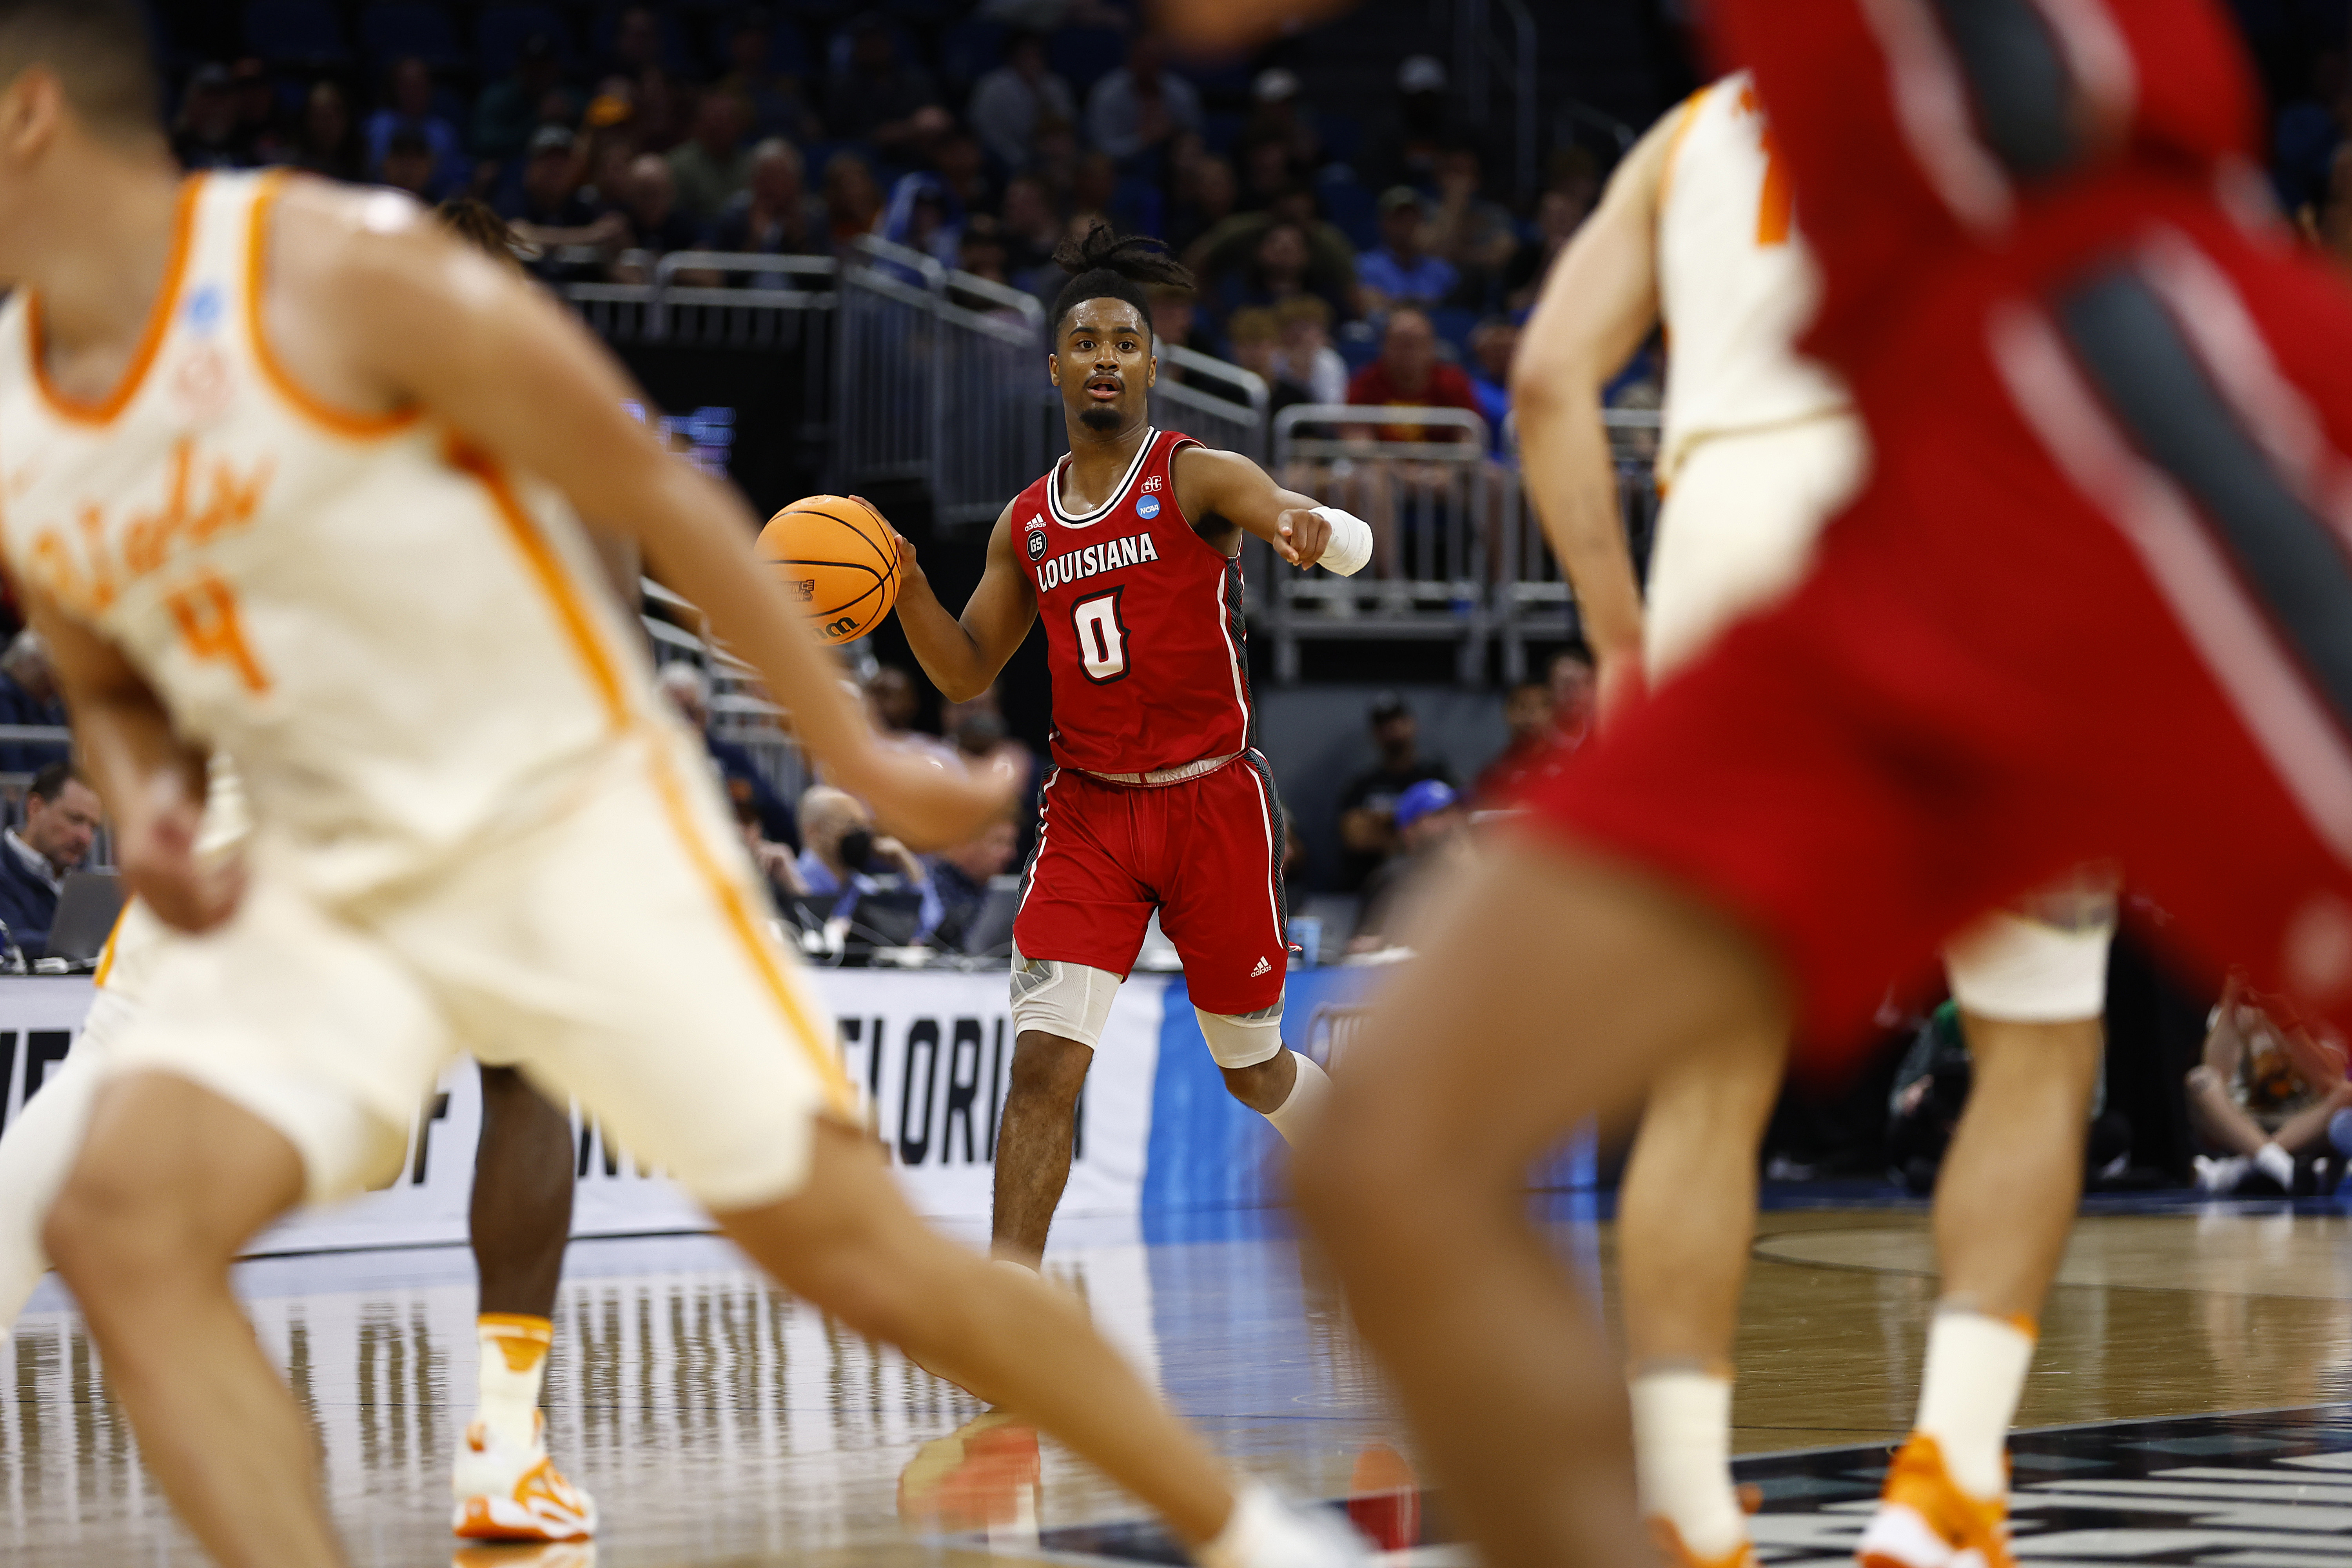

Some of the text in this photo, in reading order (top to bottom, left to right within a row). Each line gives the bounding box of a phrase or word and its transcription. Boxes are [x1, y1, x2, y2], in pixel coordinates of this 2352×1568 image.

[1140, 504, 1159, 515] NCAA
[1025, 522, 1046, 532] adidas
[1030, 536, 1043, 553] GS
[1035, 532, 1160, 593] LOUISIANA
[169, 578, 269, 692] 4
[1071, 585, 1131, 685] 0
[1251, 965, 1272, 977] adidas
